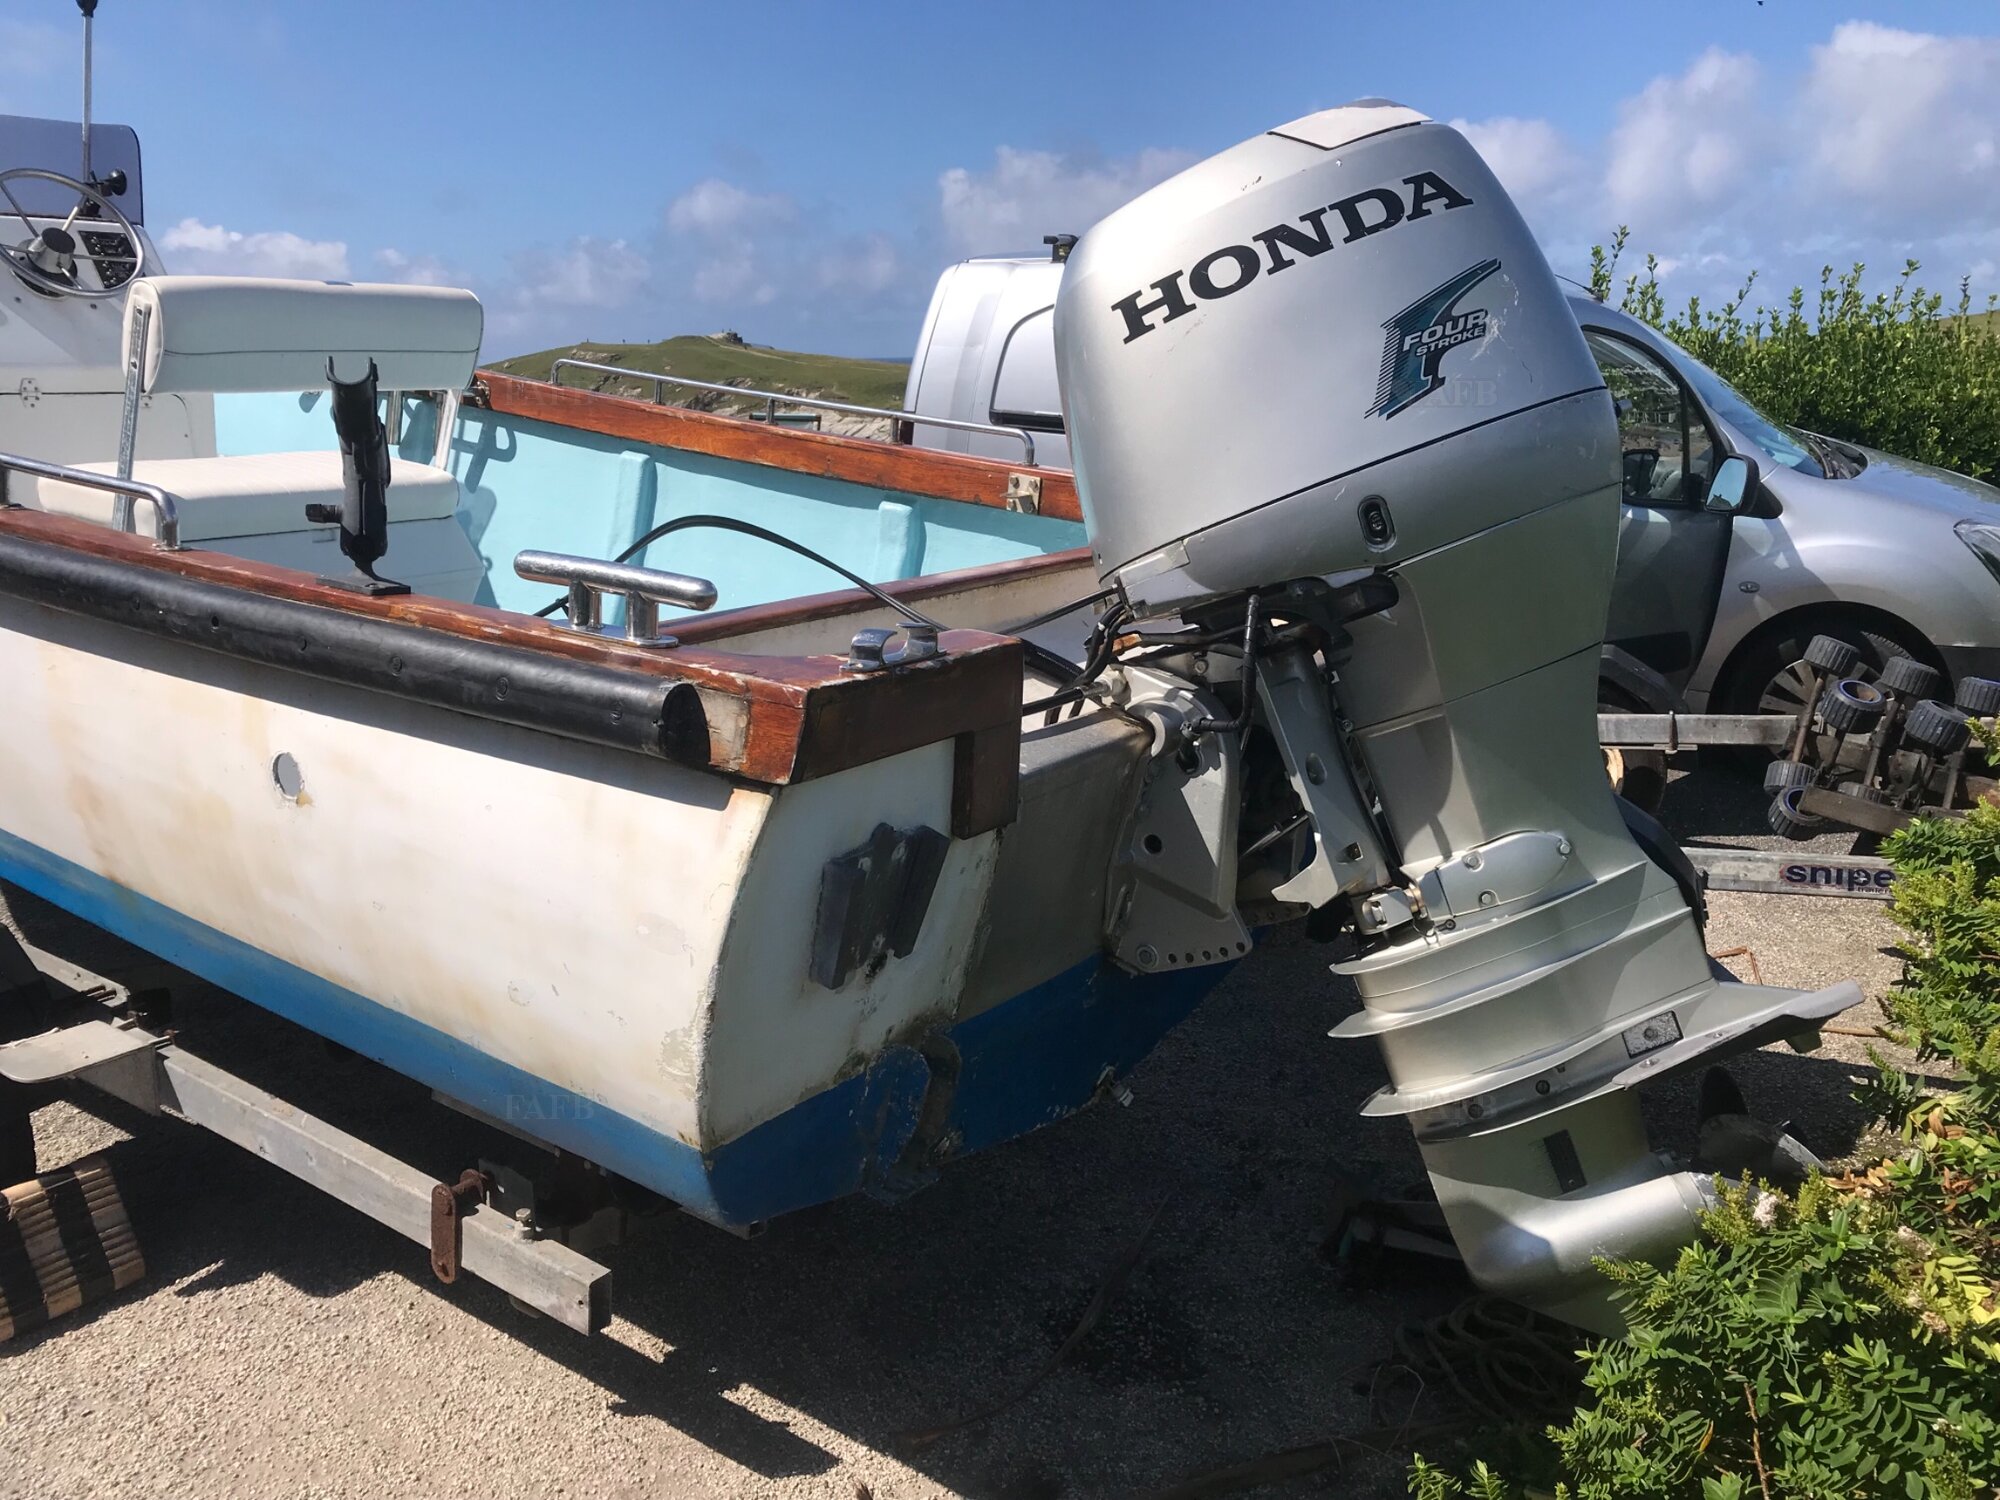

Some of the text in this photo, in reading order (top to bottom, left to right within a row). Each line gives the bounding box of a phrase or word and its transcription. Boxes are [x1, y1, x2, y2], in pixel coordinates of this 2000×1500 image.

[1111, 171, 1474, 344] HONDA
[1402, 310, 1488, 352] FOUR
[1415, 326, 1485, 357] STROKE
[1786, 865, 1896, 891] snipe
